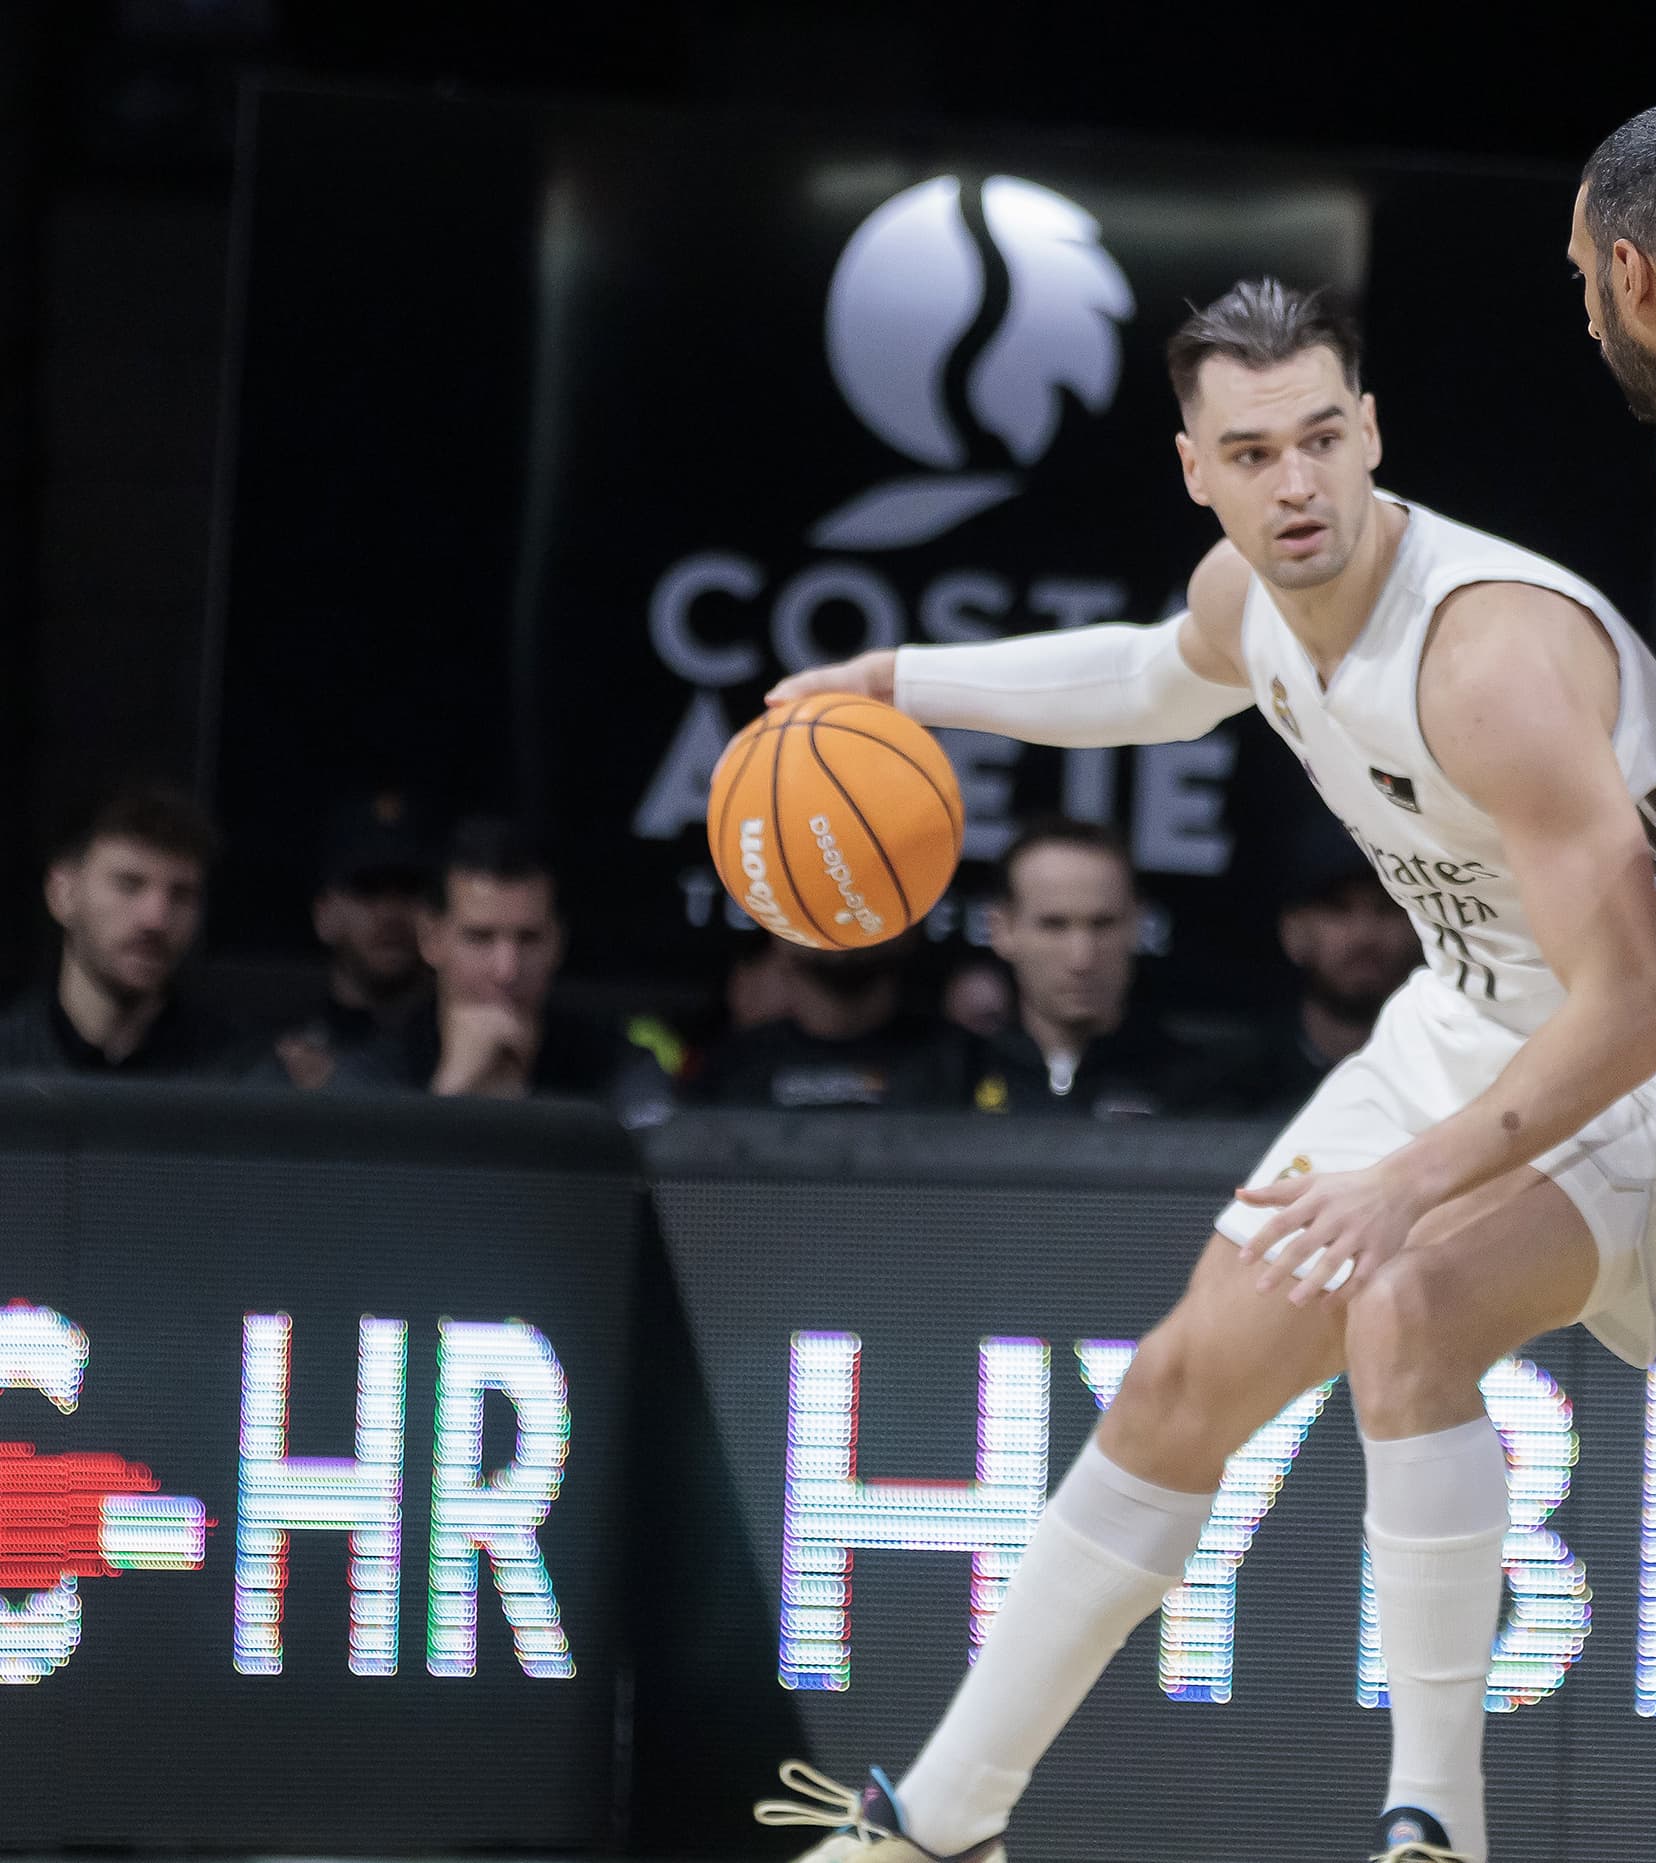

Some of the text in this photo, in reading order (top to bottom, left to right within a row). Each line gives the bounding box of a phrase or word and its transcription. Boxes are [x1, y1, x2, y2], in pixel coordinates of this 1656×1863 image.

[650, 550, 1188, 688] COST
[1355, 832, 1499, 889] rates
[1413, 891, 1499, 928] TTER
